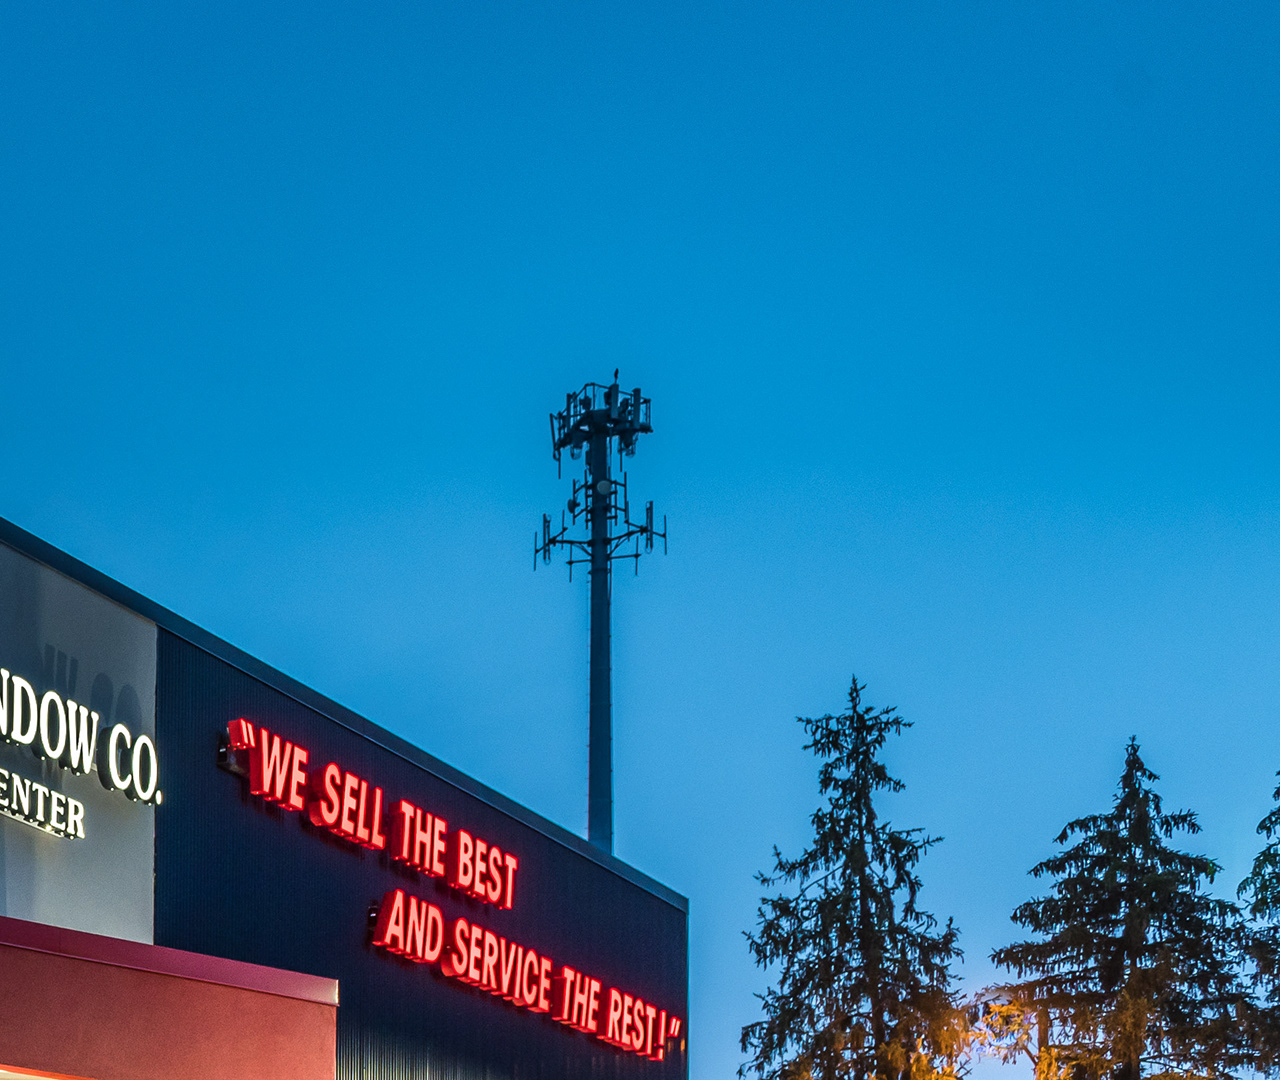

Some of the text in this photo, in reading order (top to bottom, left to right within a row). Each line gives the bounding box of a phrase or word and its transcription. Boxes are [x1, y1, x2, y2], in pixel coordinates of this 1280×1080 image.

[108, 723, 163, 806] CO.
[240, 718, 518, 910] "WE SELL THE BEST
[385, 889, 443, 962] AND
[452, 917, 552, 1013] SERVICE
[561, 966, 602, 1032] THE
